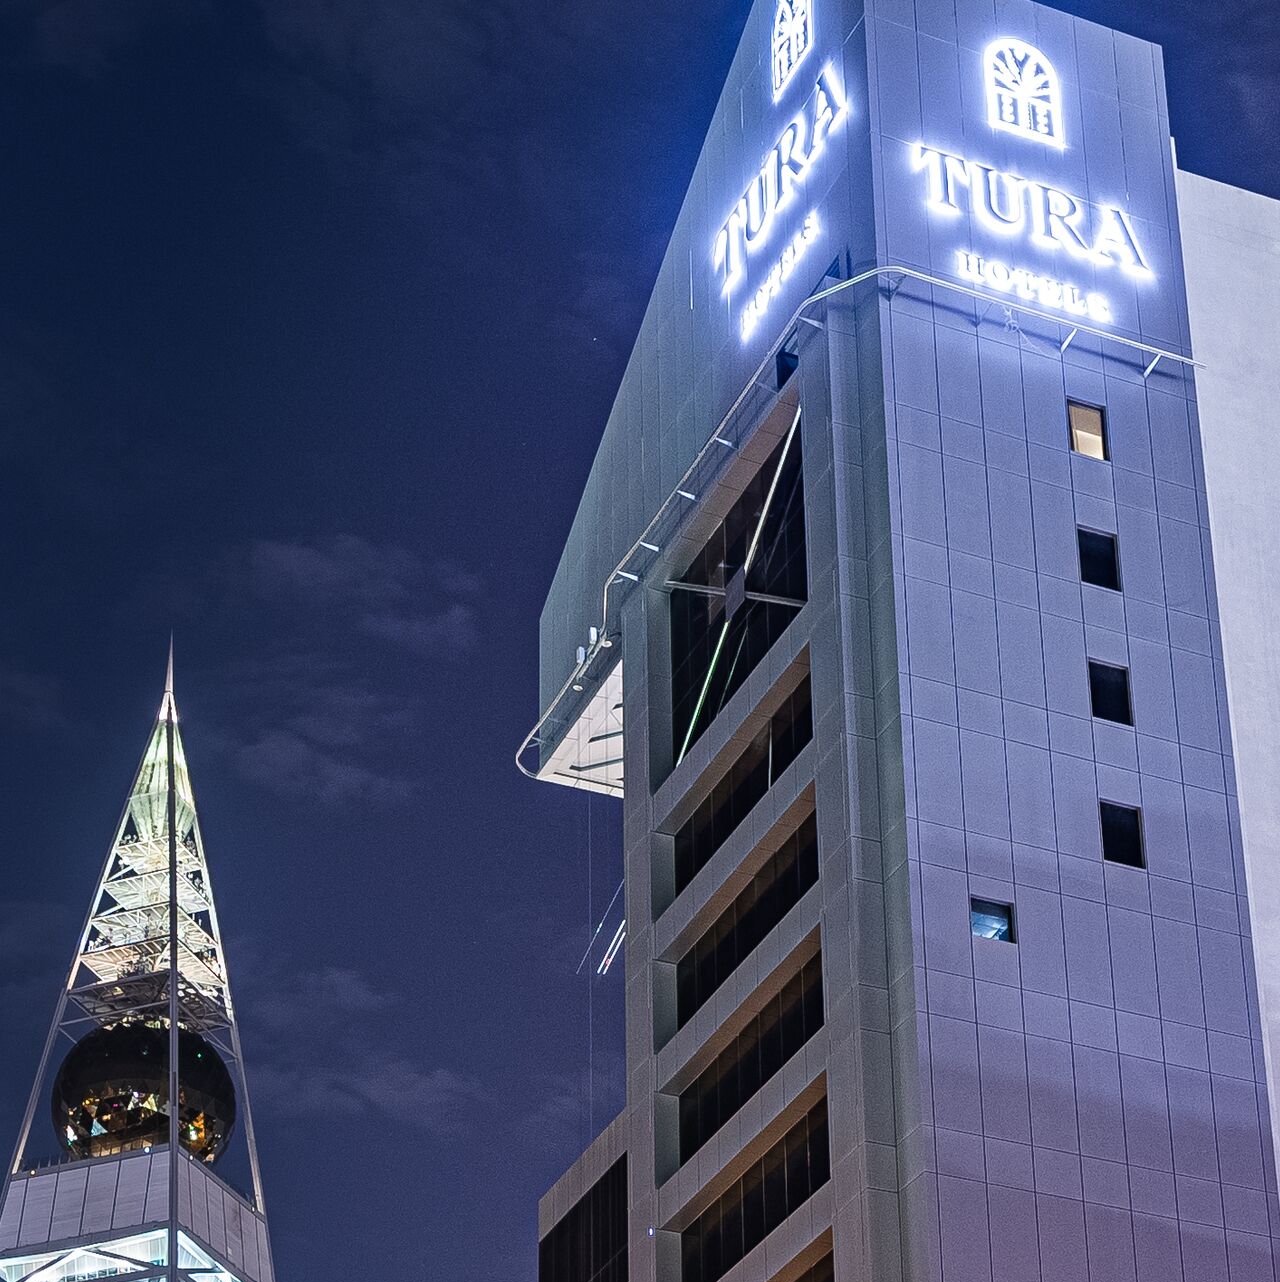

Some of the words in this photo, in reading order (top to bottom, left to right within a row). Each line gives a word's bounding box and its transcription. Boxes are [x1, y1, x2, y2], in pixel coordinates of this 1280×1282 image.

[713, 62, 848, 295] TURA
[910, 142, 1156, 280] TURA
[956, 249, 1115, 323] HOTELS
